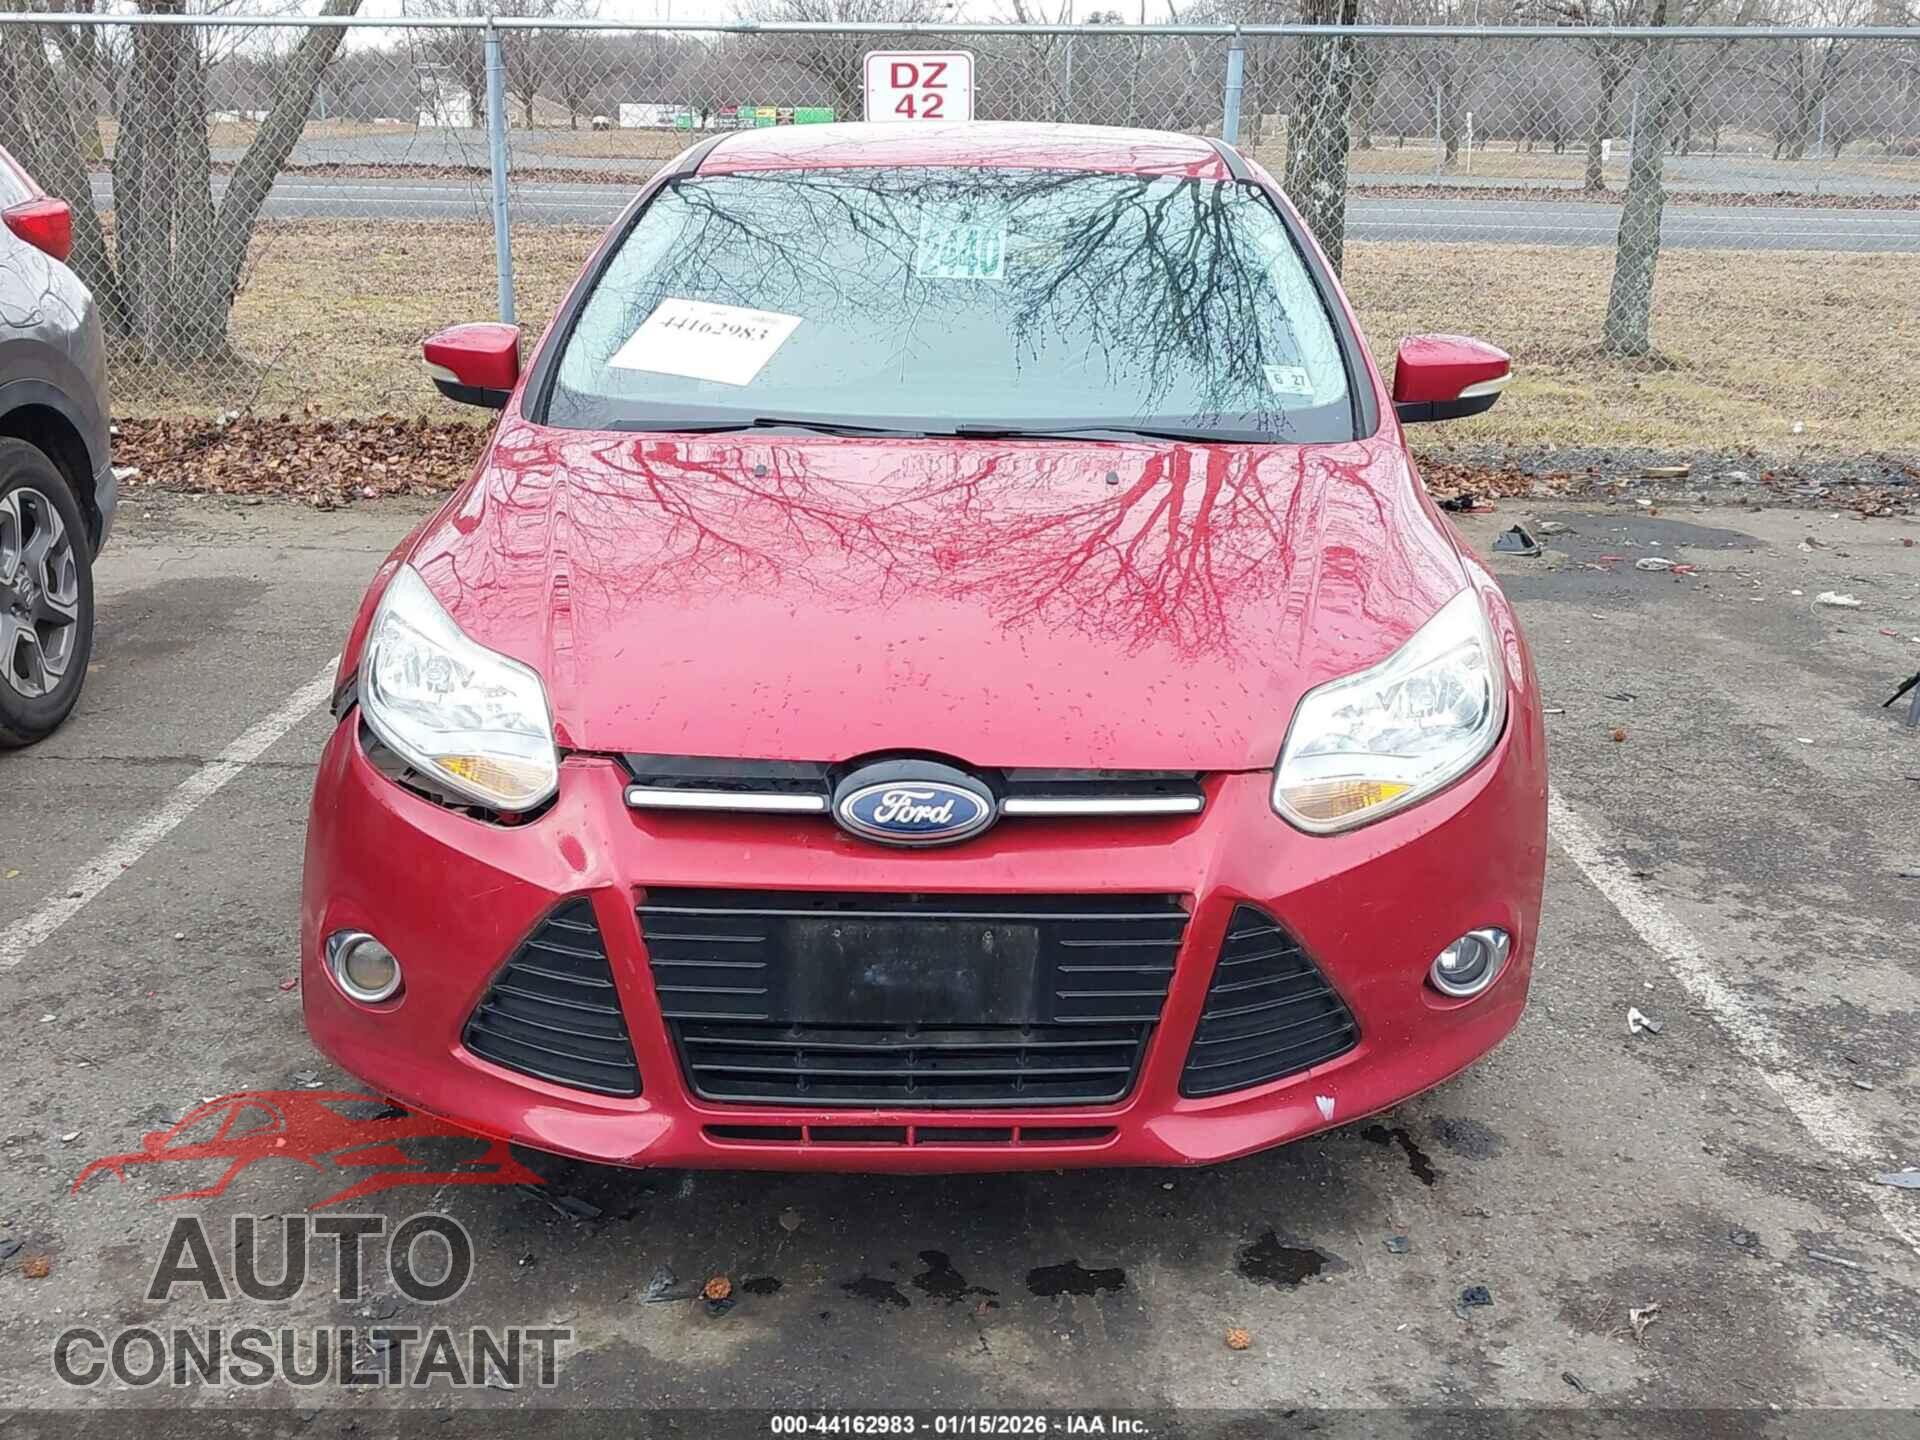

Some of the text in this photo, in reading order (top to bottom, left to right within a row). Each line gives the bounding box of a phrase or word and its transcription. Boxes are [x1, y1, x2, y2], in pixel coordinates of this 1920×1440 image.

[890, 62, 948, 89] DZ
[895, 93, 944, 119] 42
[873, 789, 953, 824] Ford
